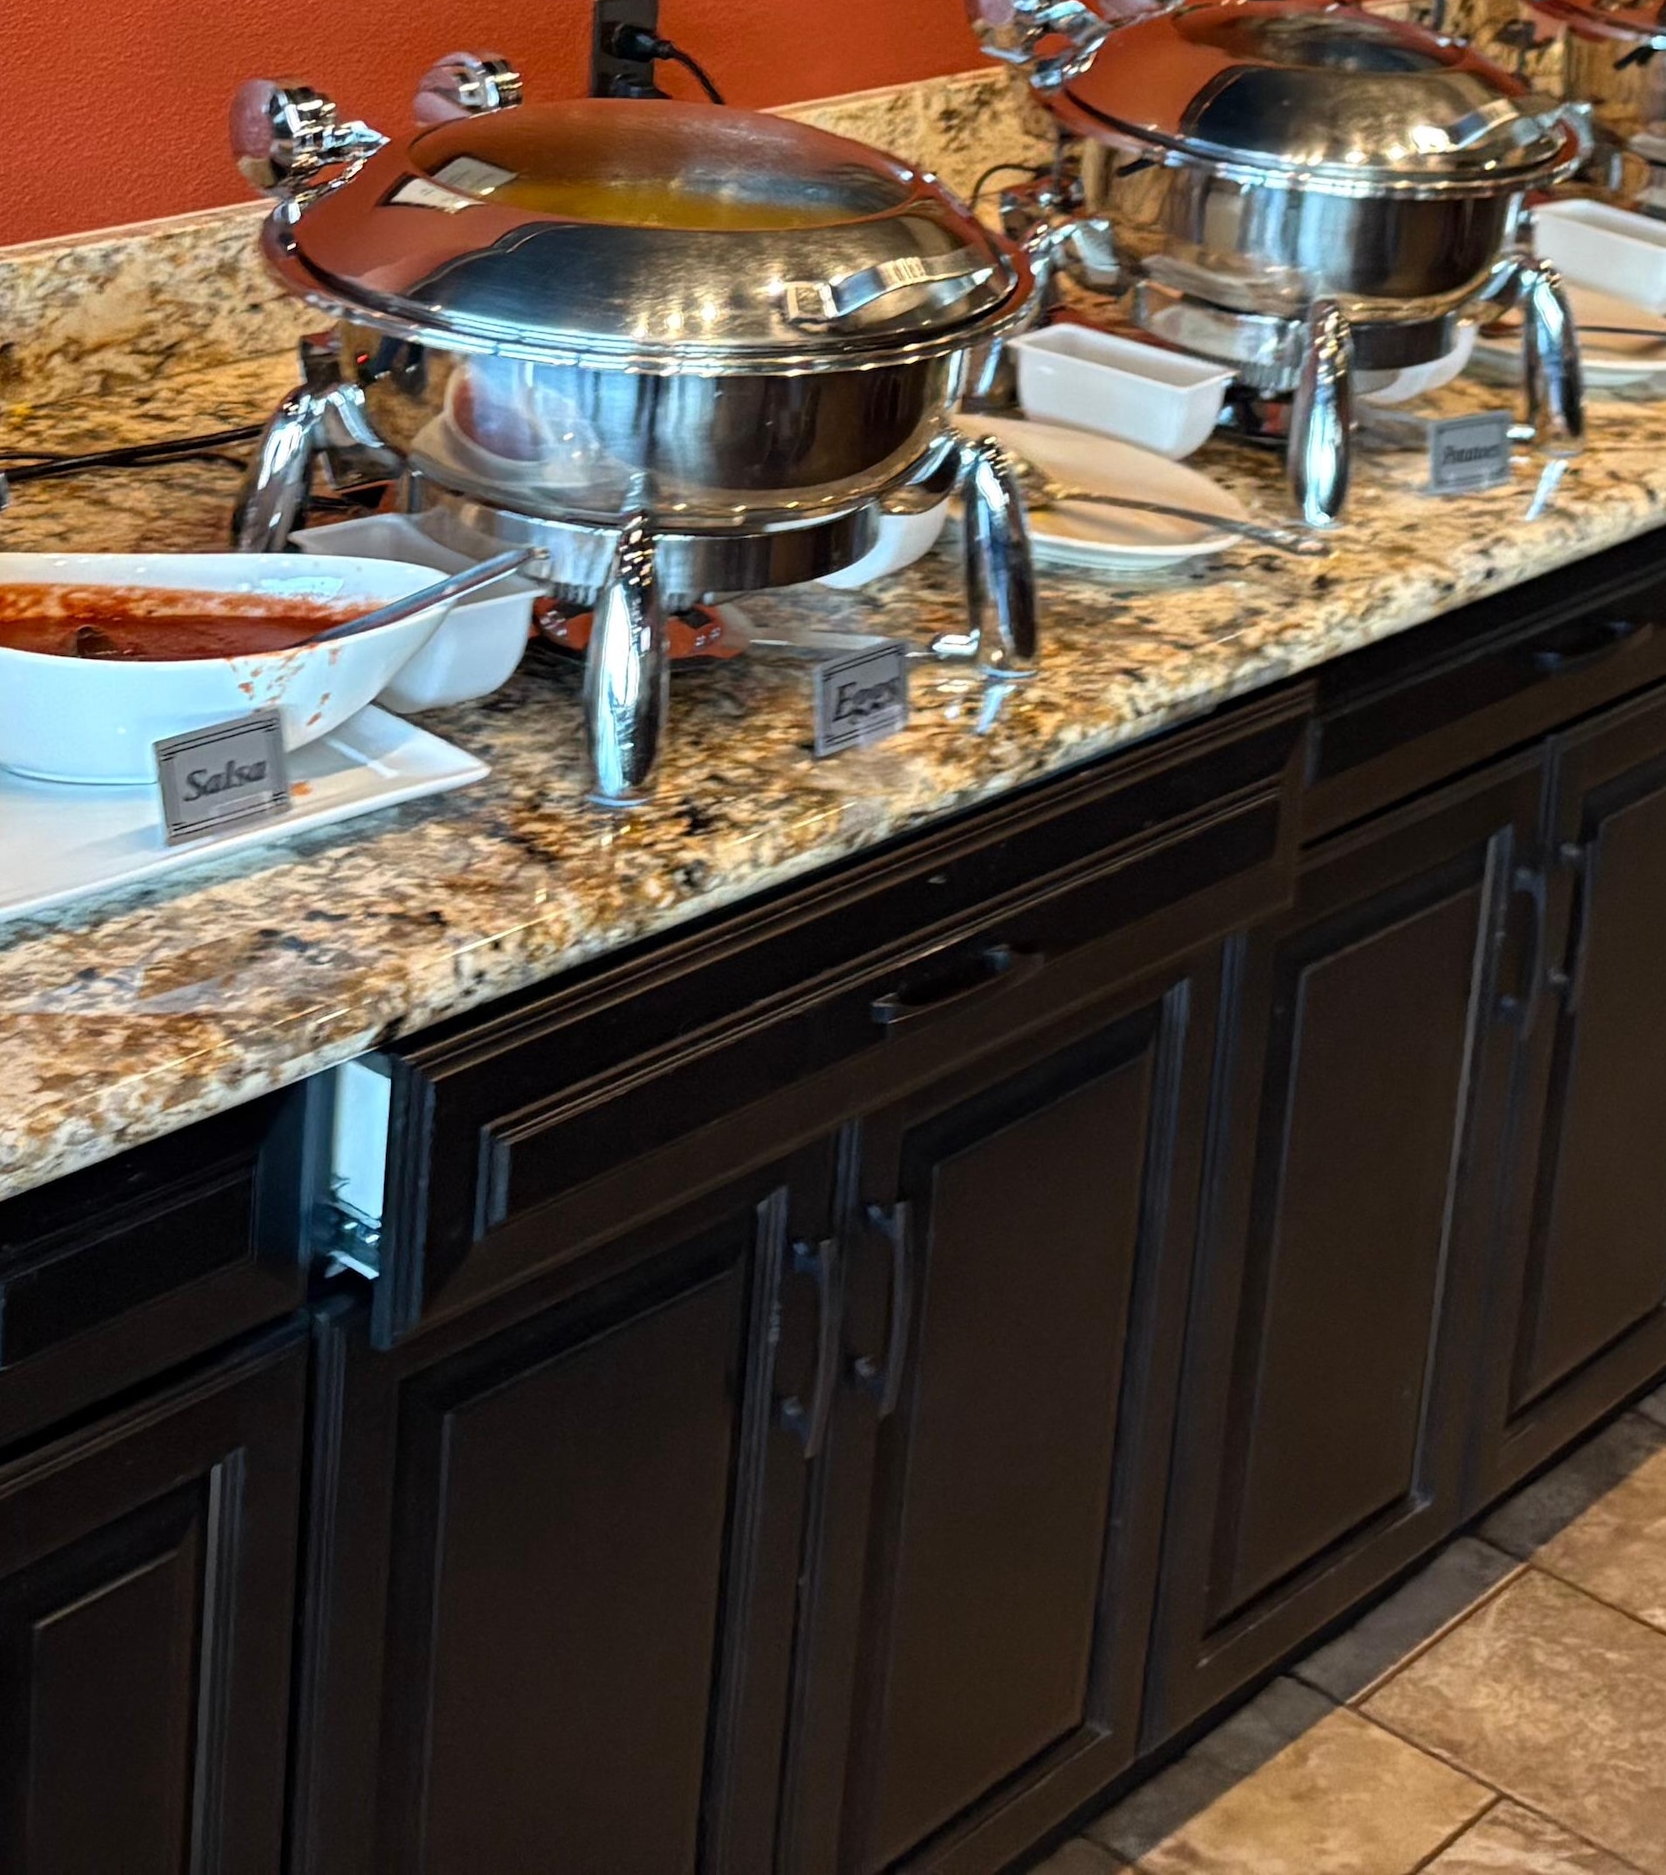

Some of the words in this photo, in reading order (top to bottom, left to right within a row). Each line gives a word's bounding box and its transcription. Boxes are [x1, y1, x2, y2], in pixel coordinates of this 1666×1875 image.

[1441, 443, 1502, 465] Potatoes
[832, 677, 901, 725] Eggs
[182, 759, 268, 802] Salsa
